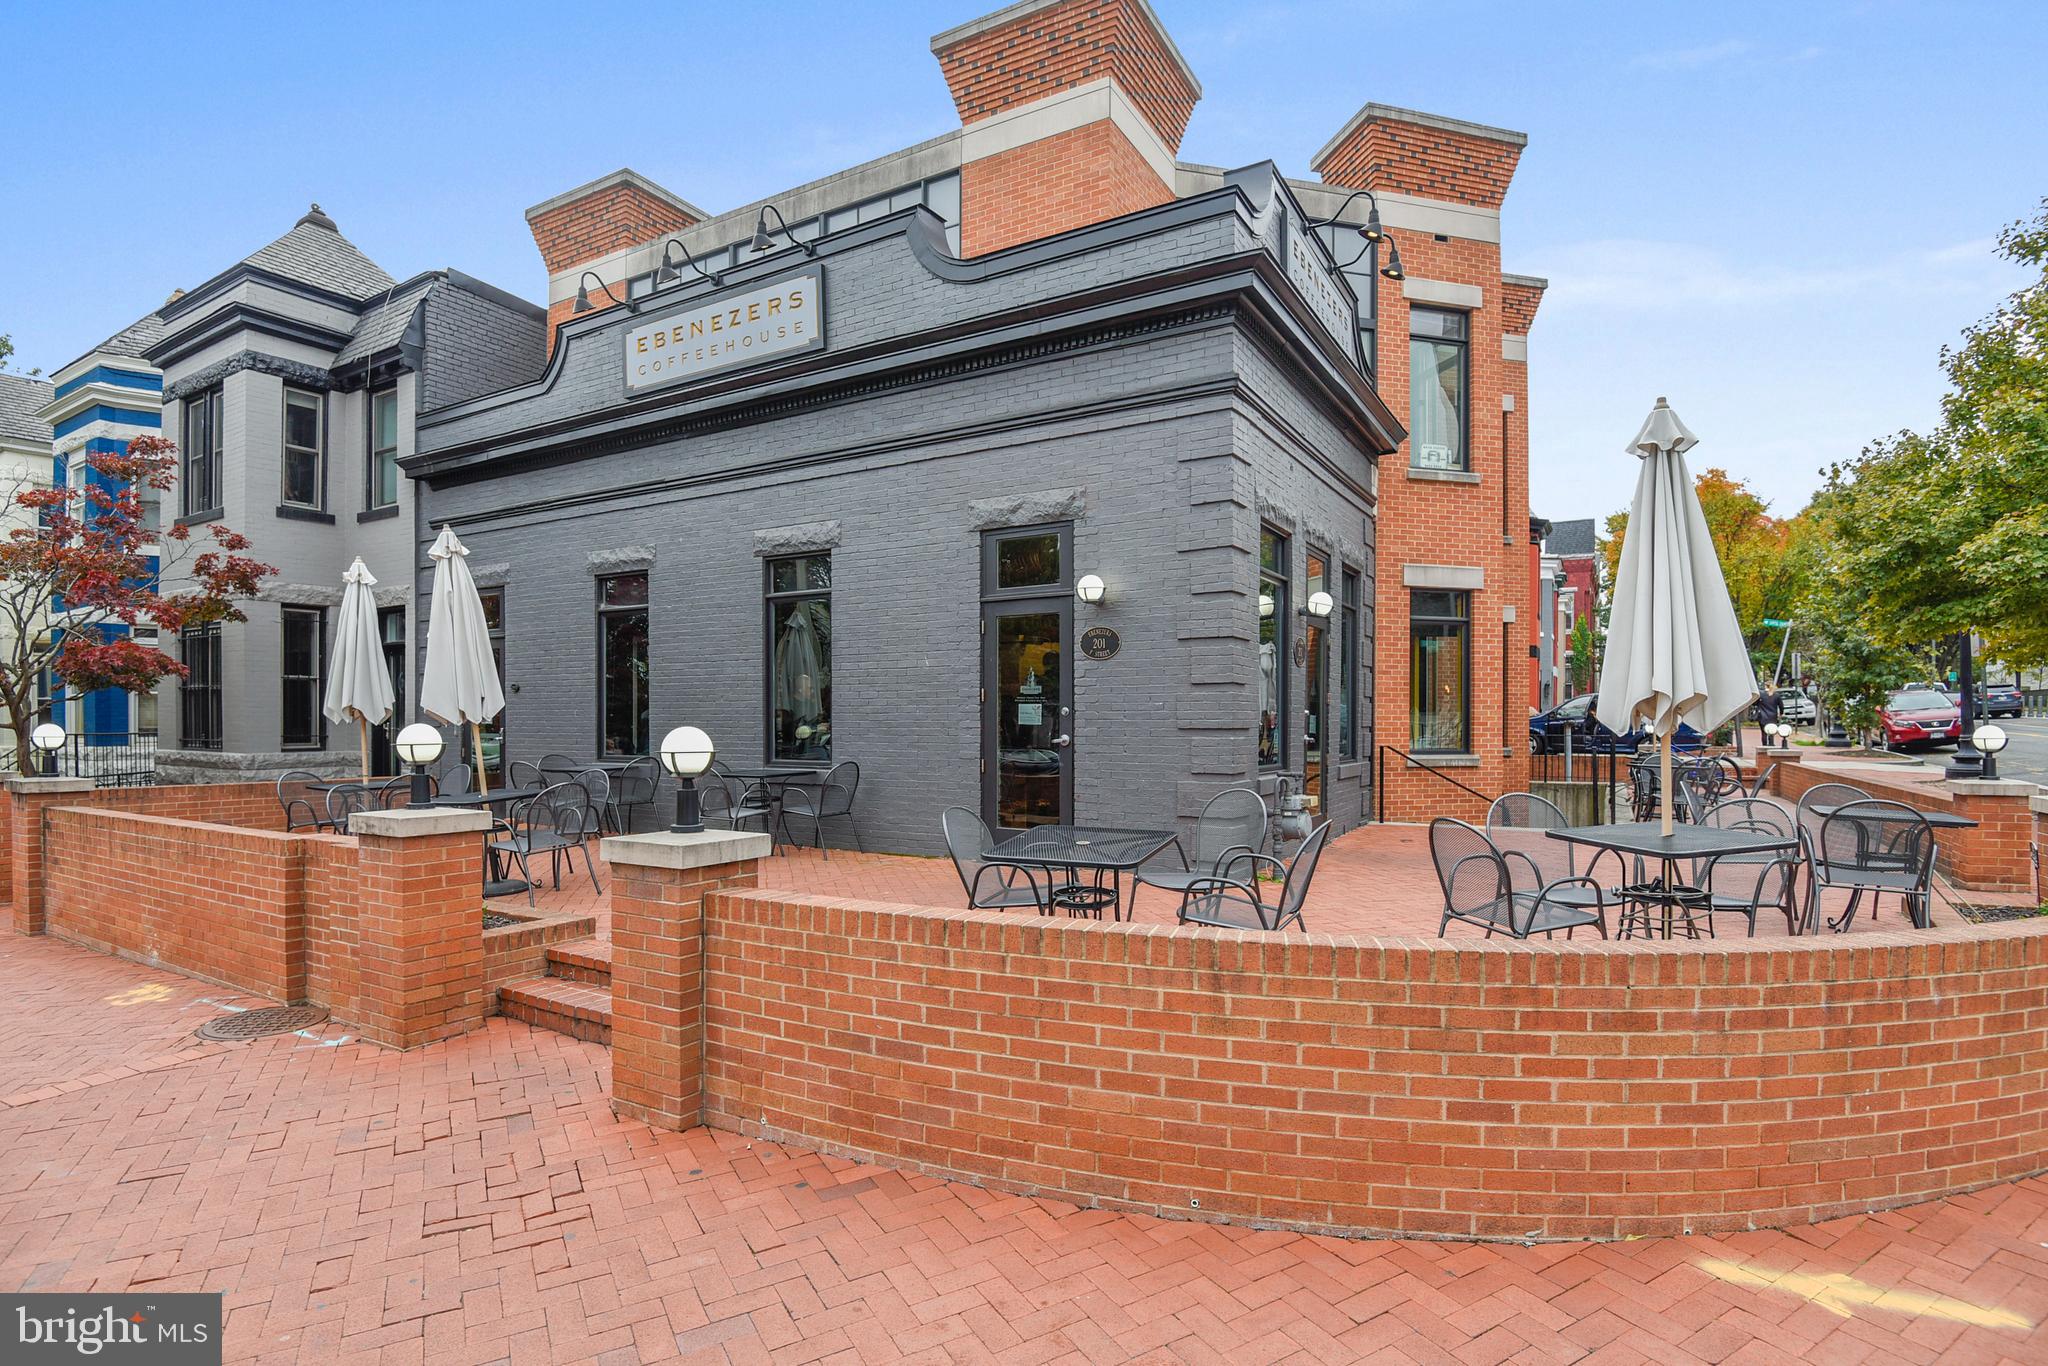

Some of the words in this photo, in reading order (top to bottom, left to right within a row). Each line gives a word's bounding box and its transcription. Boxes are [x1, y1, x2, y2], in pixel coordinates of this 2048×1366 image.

[1293, 239, 1349, 331] EBENEZERS
[637, 291, 804, 353] EBENEZERS
[638, 321, 804, 375] COFFEEHOUSE
[1092, 638, 1105, 648] 201
